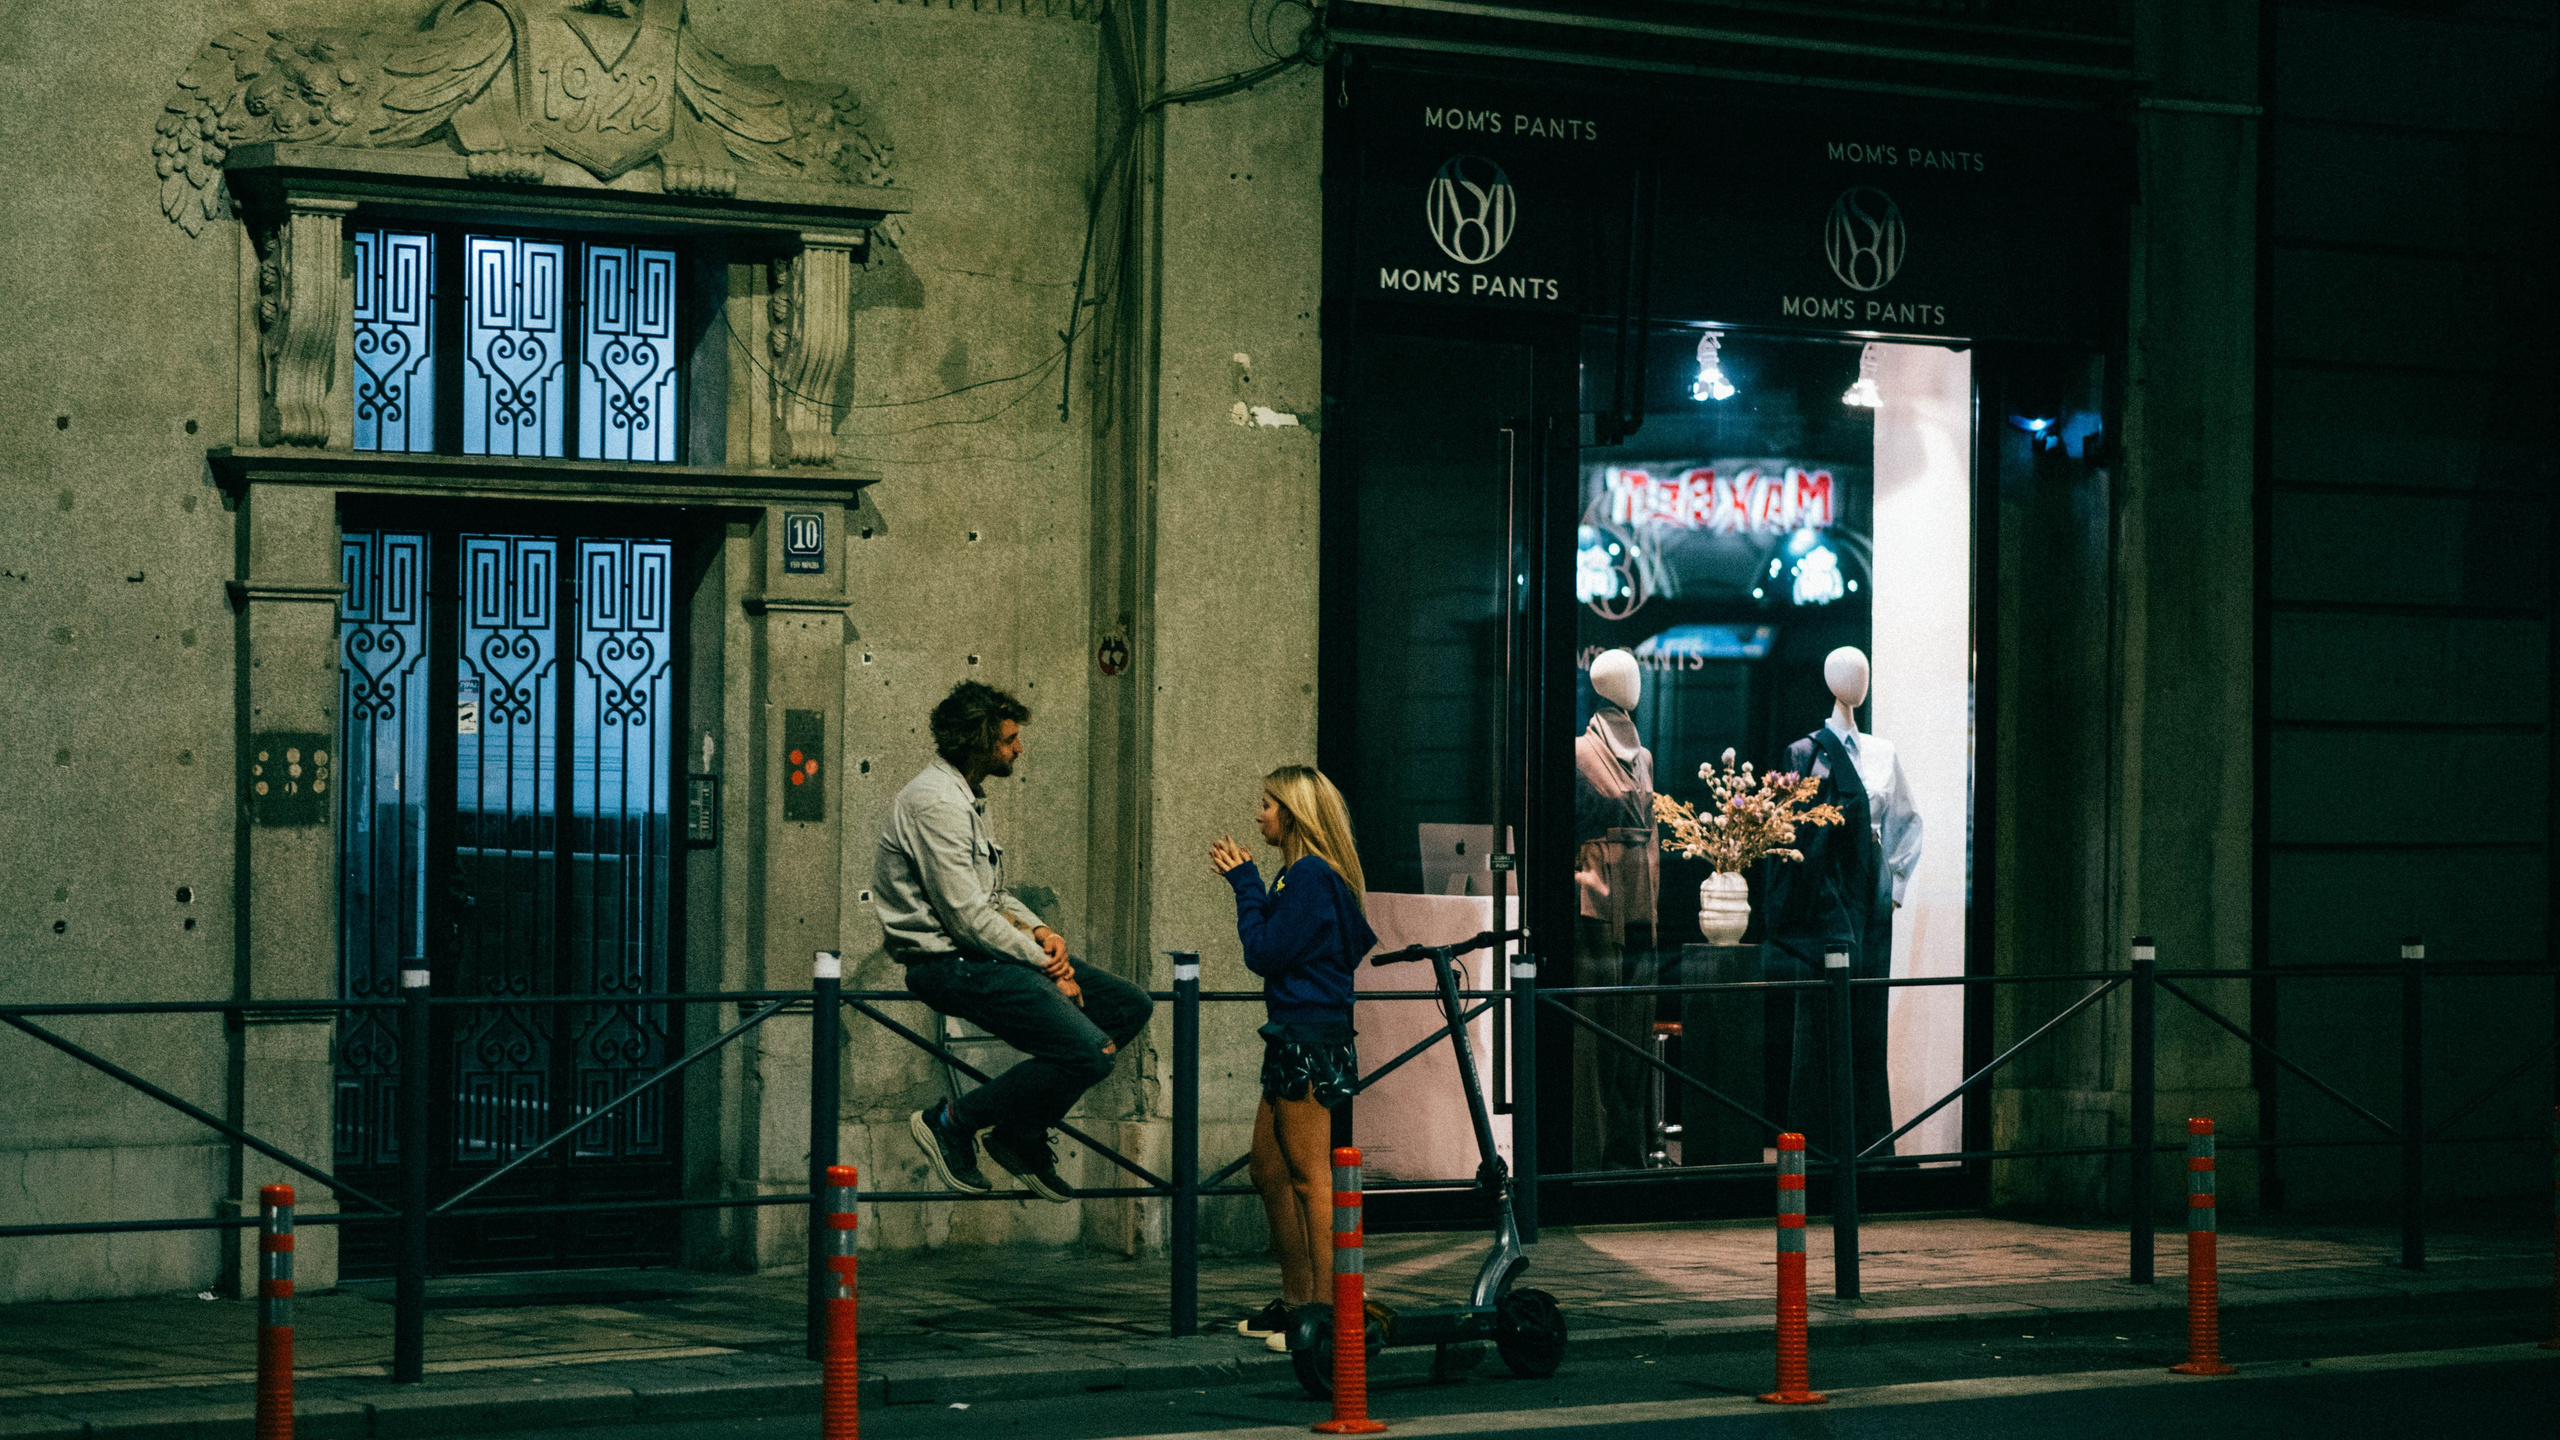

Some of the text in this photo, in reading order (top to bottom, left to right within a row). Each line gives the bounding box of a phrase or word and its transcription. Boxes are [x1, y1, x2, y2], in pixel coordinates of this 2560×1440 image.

[538, 56, 665, 135] 1922
[1425, 106, 1597, 141] MOM'S PANTS
[1827, 141, 1986, 173] MOM'S PANTS
[1380, 266, 1559, 301] MOM'S PANTS
[1782, 295, 1945, 327] MOM'S PANTS
[794, 520, 819, 549] 10
